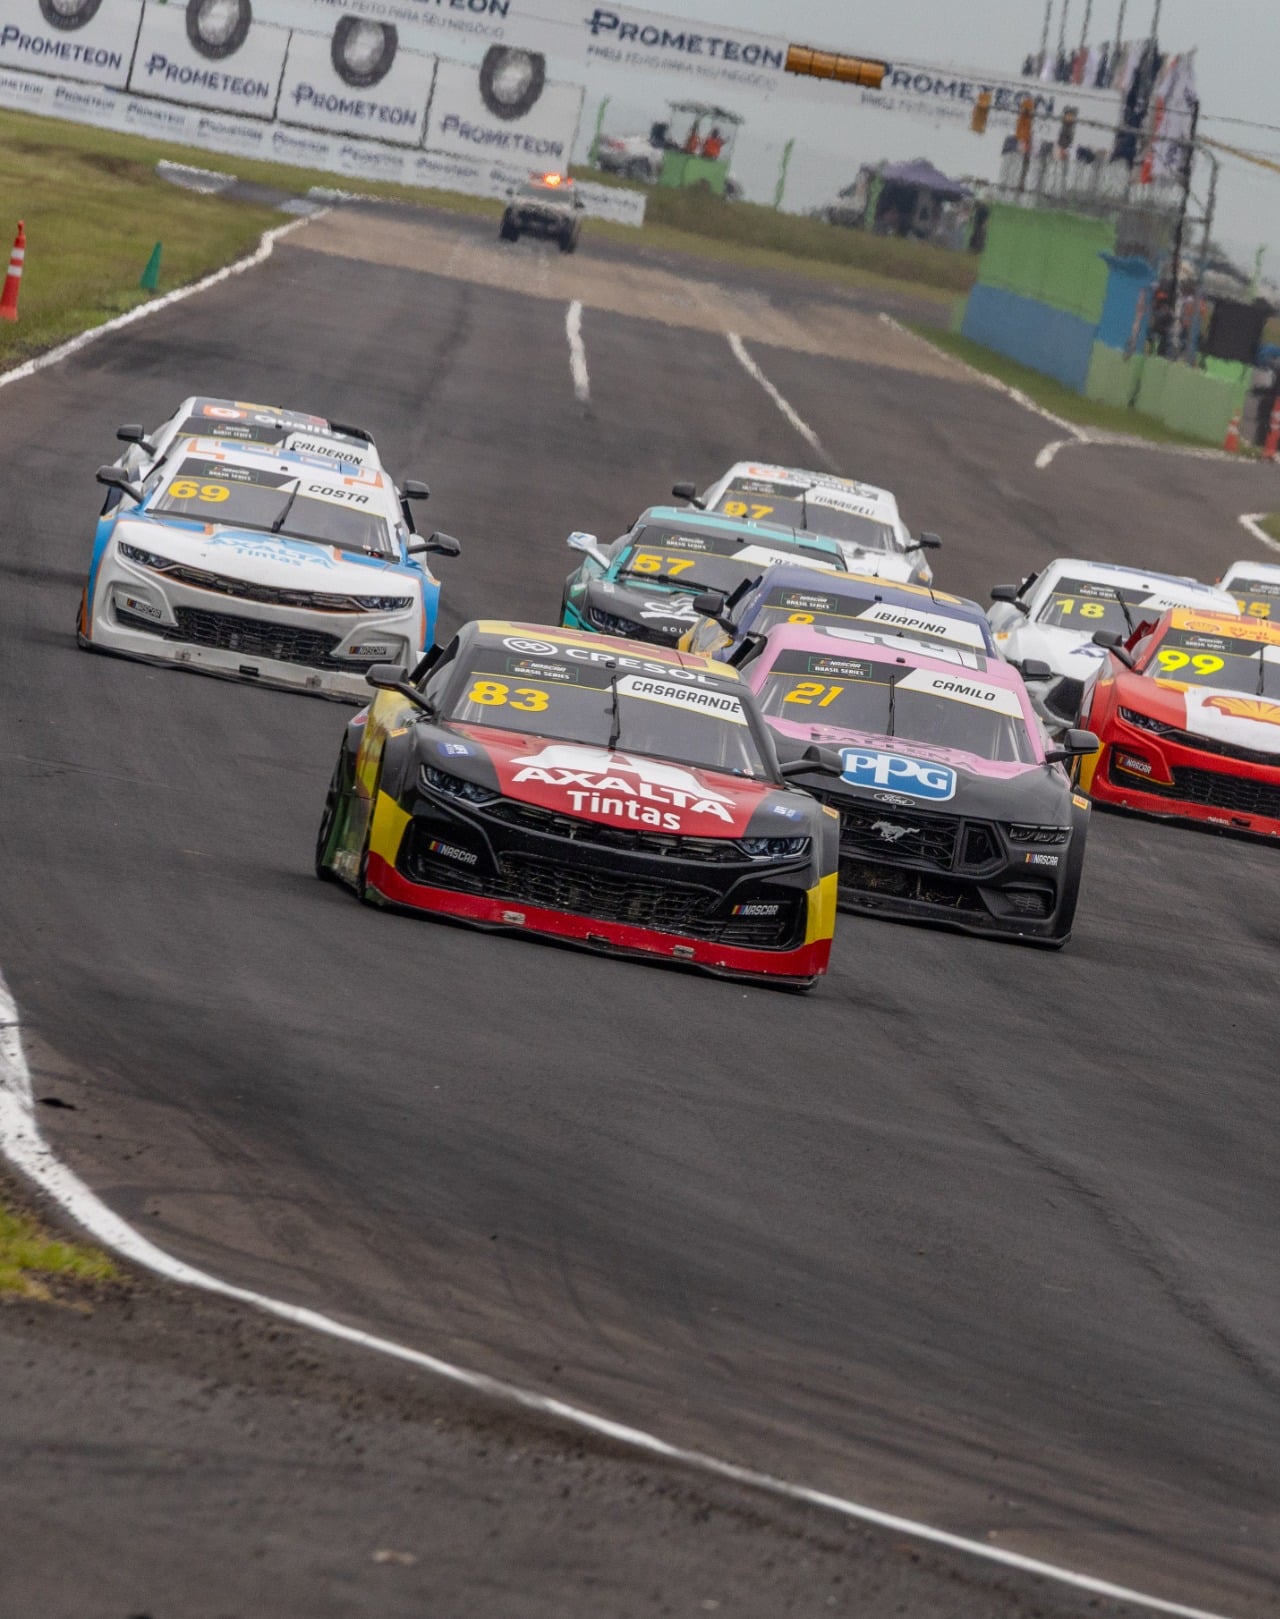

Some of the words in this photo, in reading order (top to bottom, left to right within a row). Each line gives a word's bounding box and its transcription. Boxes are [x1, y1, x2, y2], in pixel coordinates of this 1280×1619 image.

[0, 24, 123, 70] PROMETEON
[585, 8, 784, 69] PROMETEON
[145, 51, 270, 98] PROMETEON
[886, 61, 1055, 114] ROMETEON
[291, 82, 418, 127] PROMETEON
[440, 114, 565, 158] PROMETEON
[291, 440, 364, 466] CALDERON
[169, 480, 231, 503] 69
[308, 484, 370, 505] COSTA
[724, 501, 775, 520] 97
[632, 553, 695, 576] 57
[1056, 598, 1105, 619] 18
[874, 611, 948, 635] IBIAPINA
[514, 667, 542, 677] BRASIL
[543, 671, 571, 680] SERIES
[530, 661, 567, 673] NASCAR
[566, 648, 719, 686] CRESOL
[814, 665, 839, 674] BRASIL
[841, 668, 865, 676] SERIES
[829, 659, 862, 669] NASCAR
[1157, 650, 1225, 676] 99
[468, 680, 550, 713] 83
[631, 681, 742, 714] CASAGRANDE
[783, 681, 845, 708] 21
[932, 679, 997, 702] CAMILO
[845, 754, 950, 791] PPG
[1126, 759, 1152, 775] NASCAR
[512, 767, 735, 824] AXALTA
[567, 790, 681, 830] Tintas
[440, 843, 478, 865] NASCAR
[1034, 854, 1059, 866] NASCAR
[742, 904, 780, 916] NASCAR
